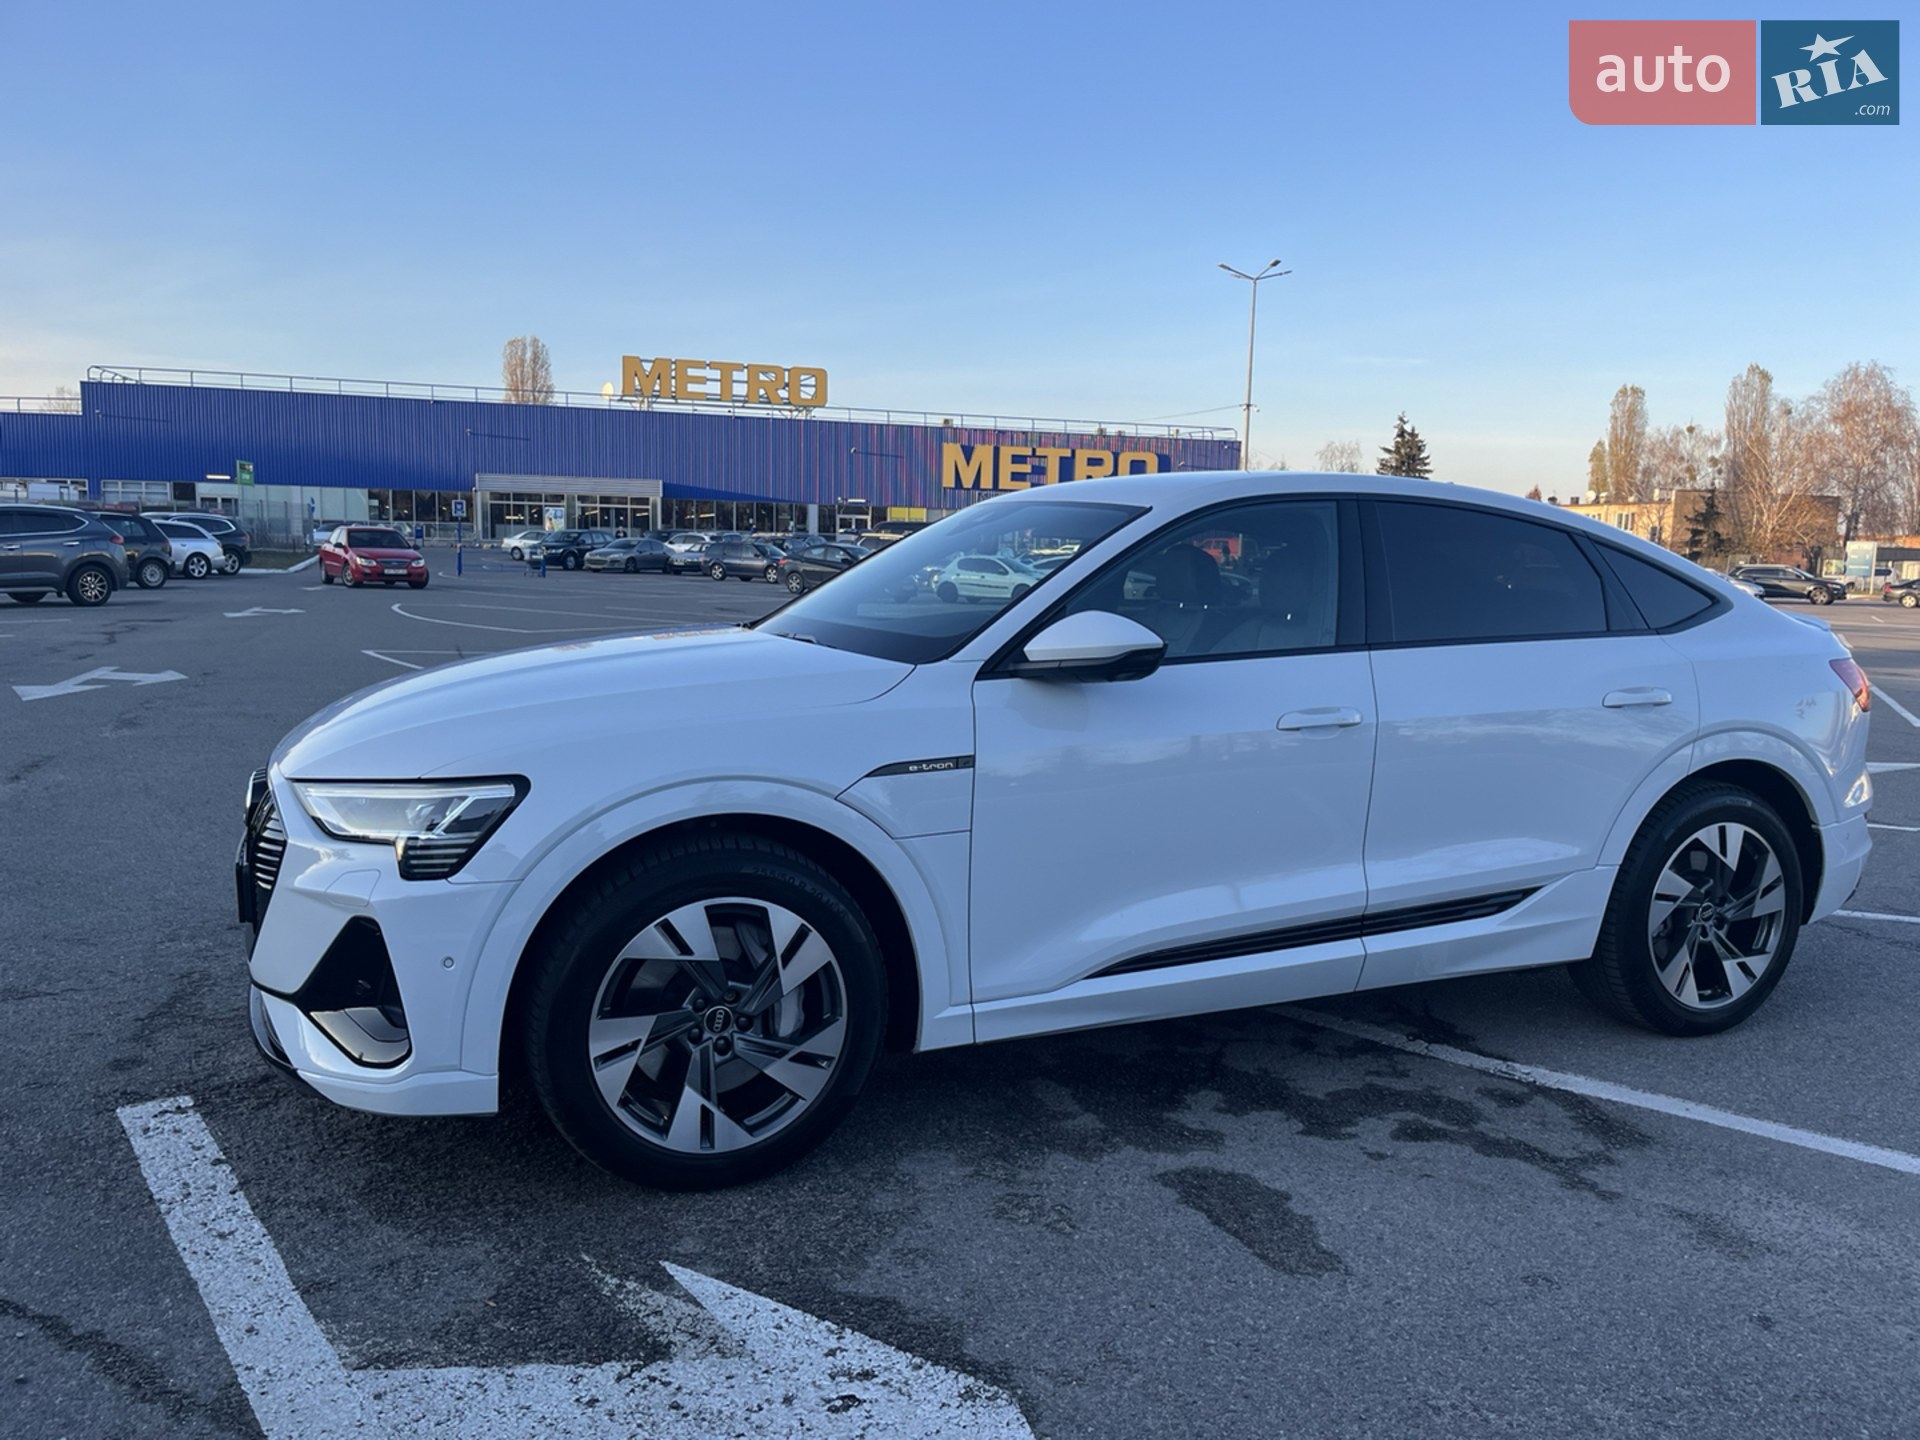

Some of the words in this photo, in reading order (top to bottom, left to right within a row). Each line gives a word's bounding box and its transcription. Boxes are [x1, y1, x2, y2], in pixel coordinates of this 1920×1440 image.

[622, 355, 828, 407] METRO
[908, 761, 954, 772] e-tron
[752, 866, 795, 886] 255/50
[798, 880, 807, 890] R
